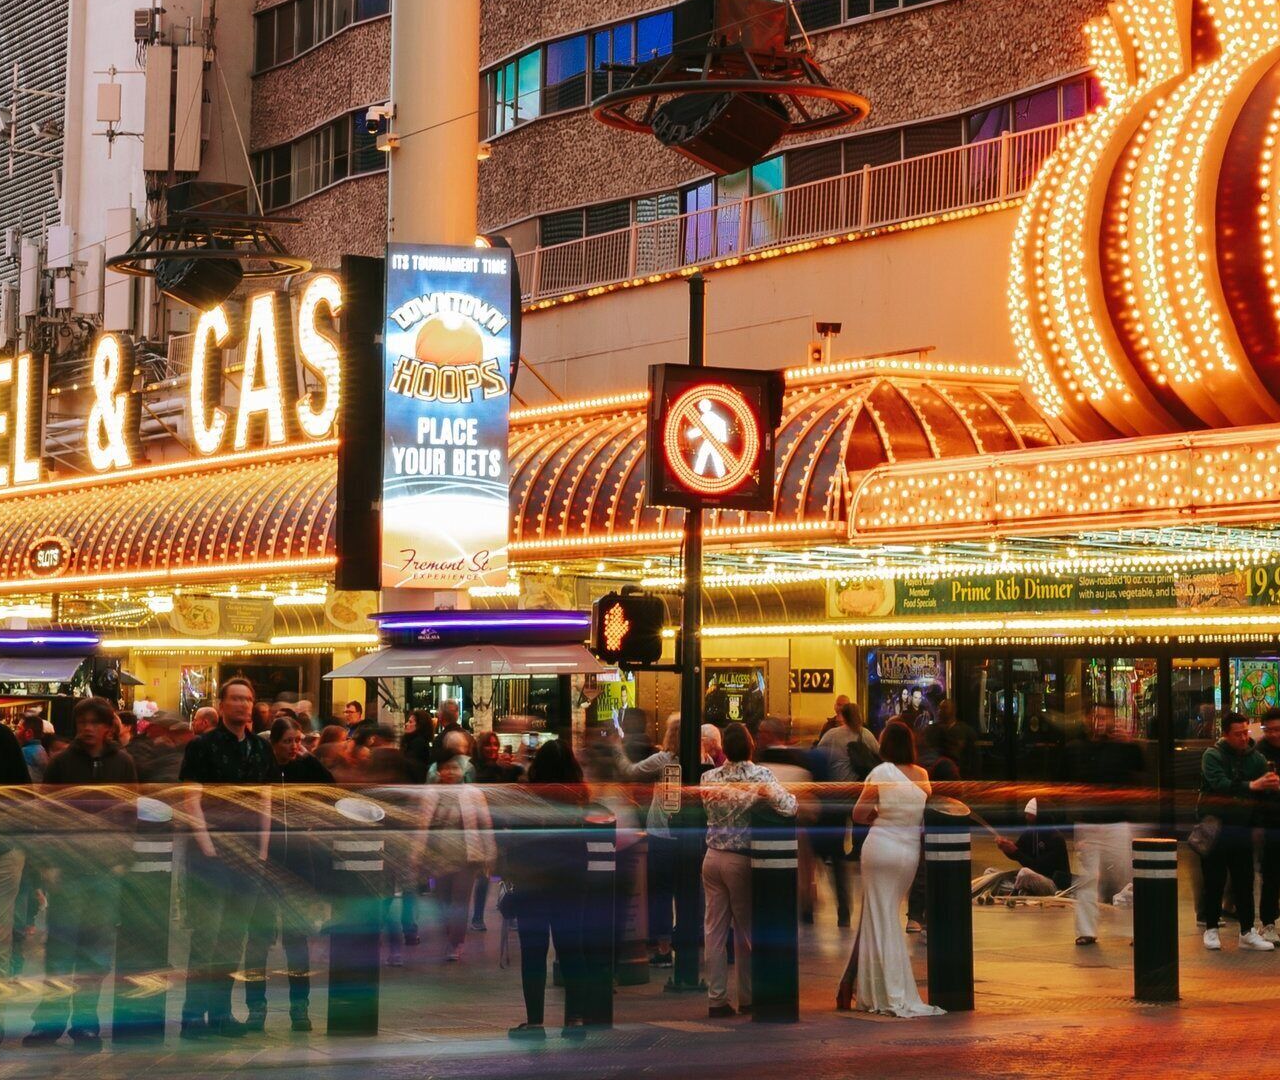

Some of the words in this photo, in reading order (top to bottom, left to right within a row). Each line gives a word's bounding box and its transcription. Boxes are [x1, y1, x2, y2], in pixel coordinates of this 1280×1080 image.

[392, 254, 410, 270] ITS
[412, 255, 480, 274] TOURNAMENT
[482, 258, 507, 275] TIME
[390, 291, 509, 336] DOWNTOWN
[389, 355, 508, 404] HOOPS
[86, 333, 132, 471] &
[417, 417, 478, 446] PLACE
[393, 447, 446, 475] YOUR
[453, 449, 502, 477] BETS
[400, 548, 465, 571] Fremont
[468, 550, 492, 572] St.
[413, 573, 479, 581] EXPERIENCE
[1144, 575, 1155, 584] cut
[1157, 574, 1179, 585] prim
[909, 588, 930, 597] Member
[952, 580, 992, 602] Prime
[996, 578, 1020, 601] Rib
[1024, 576, 1074, 600] Dinner
[1078, 589, 1094, 599] with
[1095, 590, 1104, 598] au
[1118, 587, 1155, 600] vegetable,
[1155, 586, 1170, 597] and
[904, 599, 916, 608] Food
[917, 598, 937, 608] Specials
[882, 653, 936, 668] HYPNOSIS
[719, 673, 730, 684] ALL
[731, 673, 750, 684] ACCESS
[803, 672, 830, 688] 202
